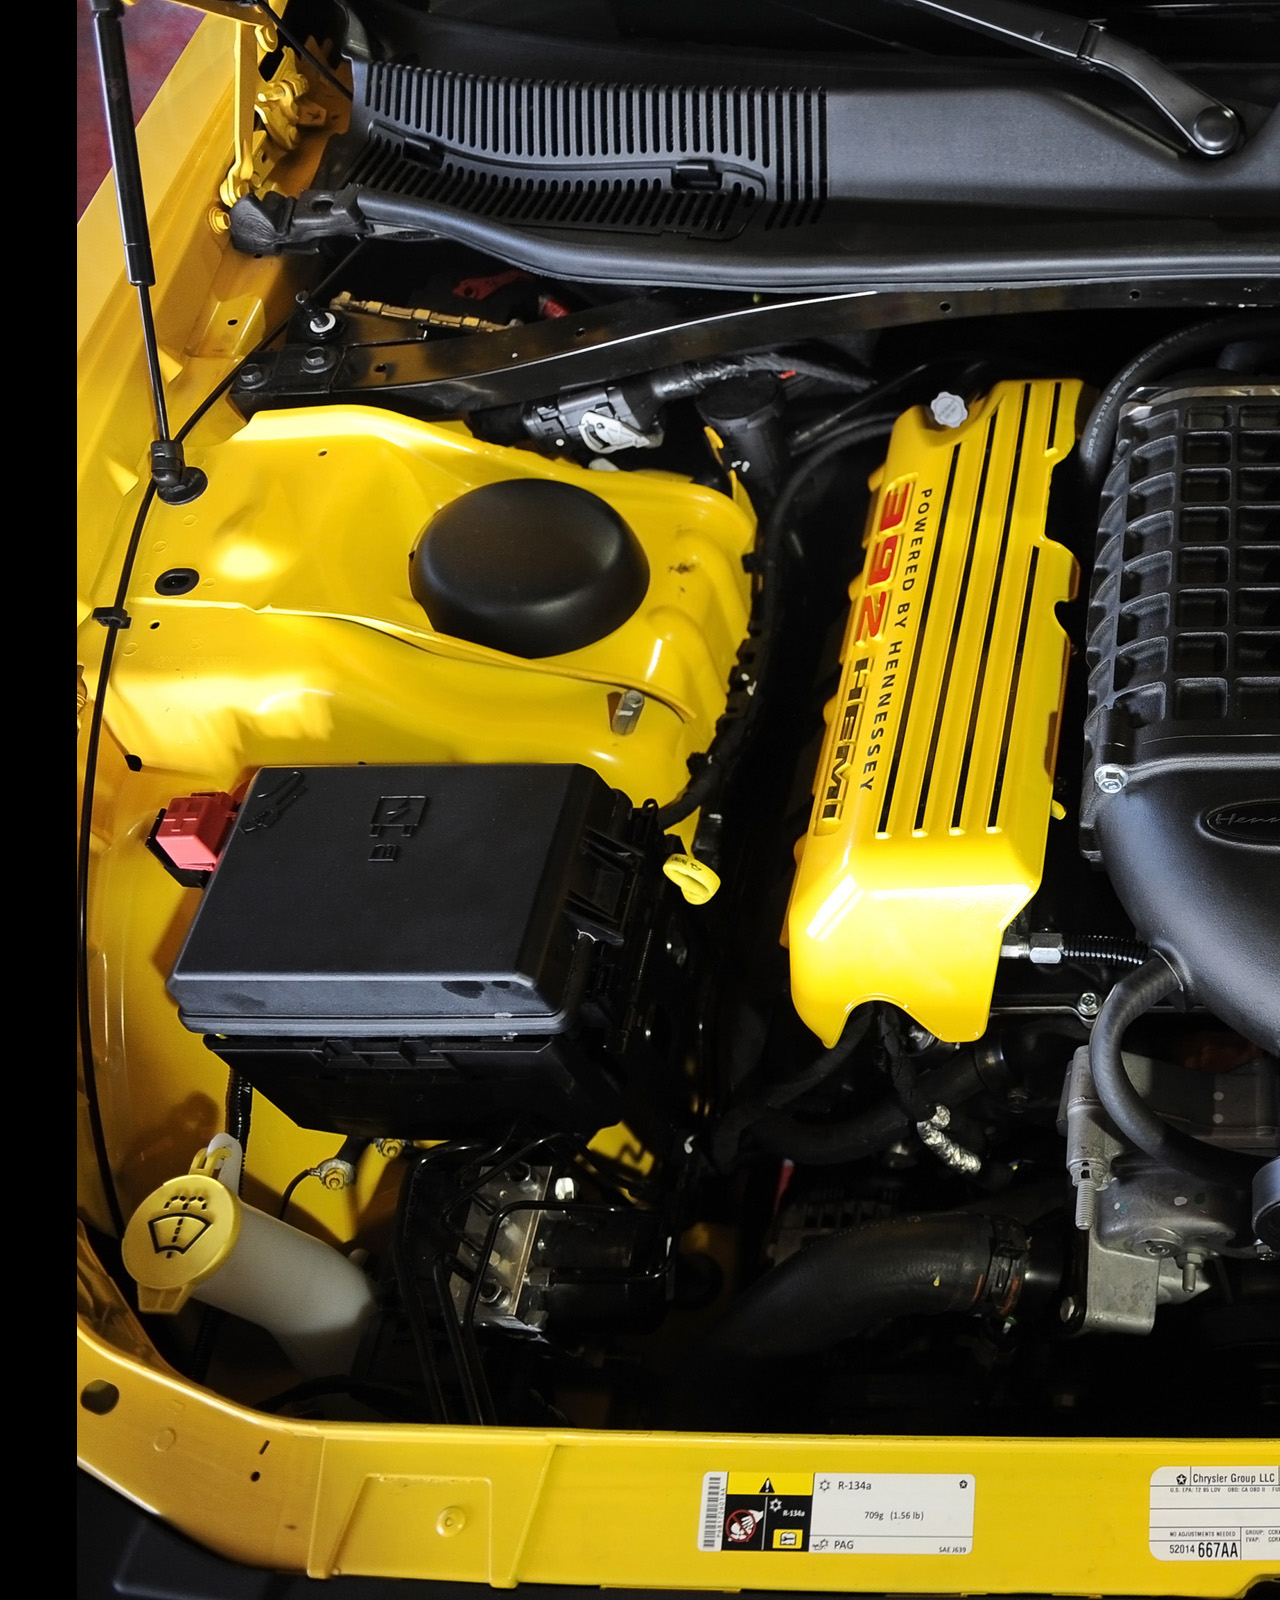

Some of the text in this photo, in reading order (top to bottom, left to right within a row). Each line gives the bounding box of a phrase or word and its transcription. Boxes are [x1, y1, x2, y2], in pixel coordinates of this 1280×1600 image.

[860, 488, 932, 792] POWERED BY HENNESSEY
[822, 482, 911, 819] 392 HEMI
[1192, 1473, 1275, 1485] Chrysler Group LLC
[837, 1480, 872, 1491] R-134a
[782, 1508, 806, 1518] R-134a
[864, 1510, 924, 1522] 709g (1.56 lb)
[834, 1540, 854, 1550] PAG
[1169, 1542, 1238, 1558] 52014 667AA
